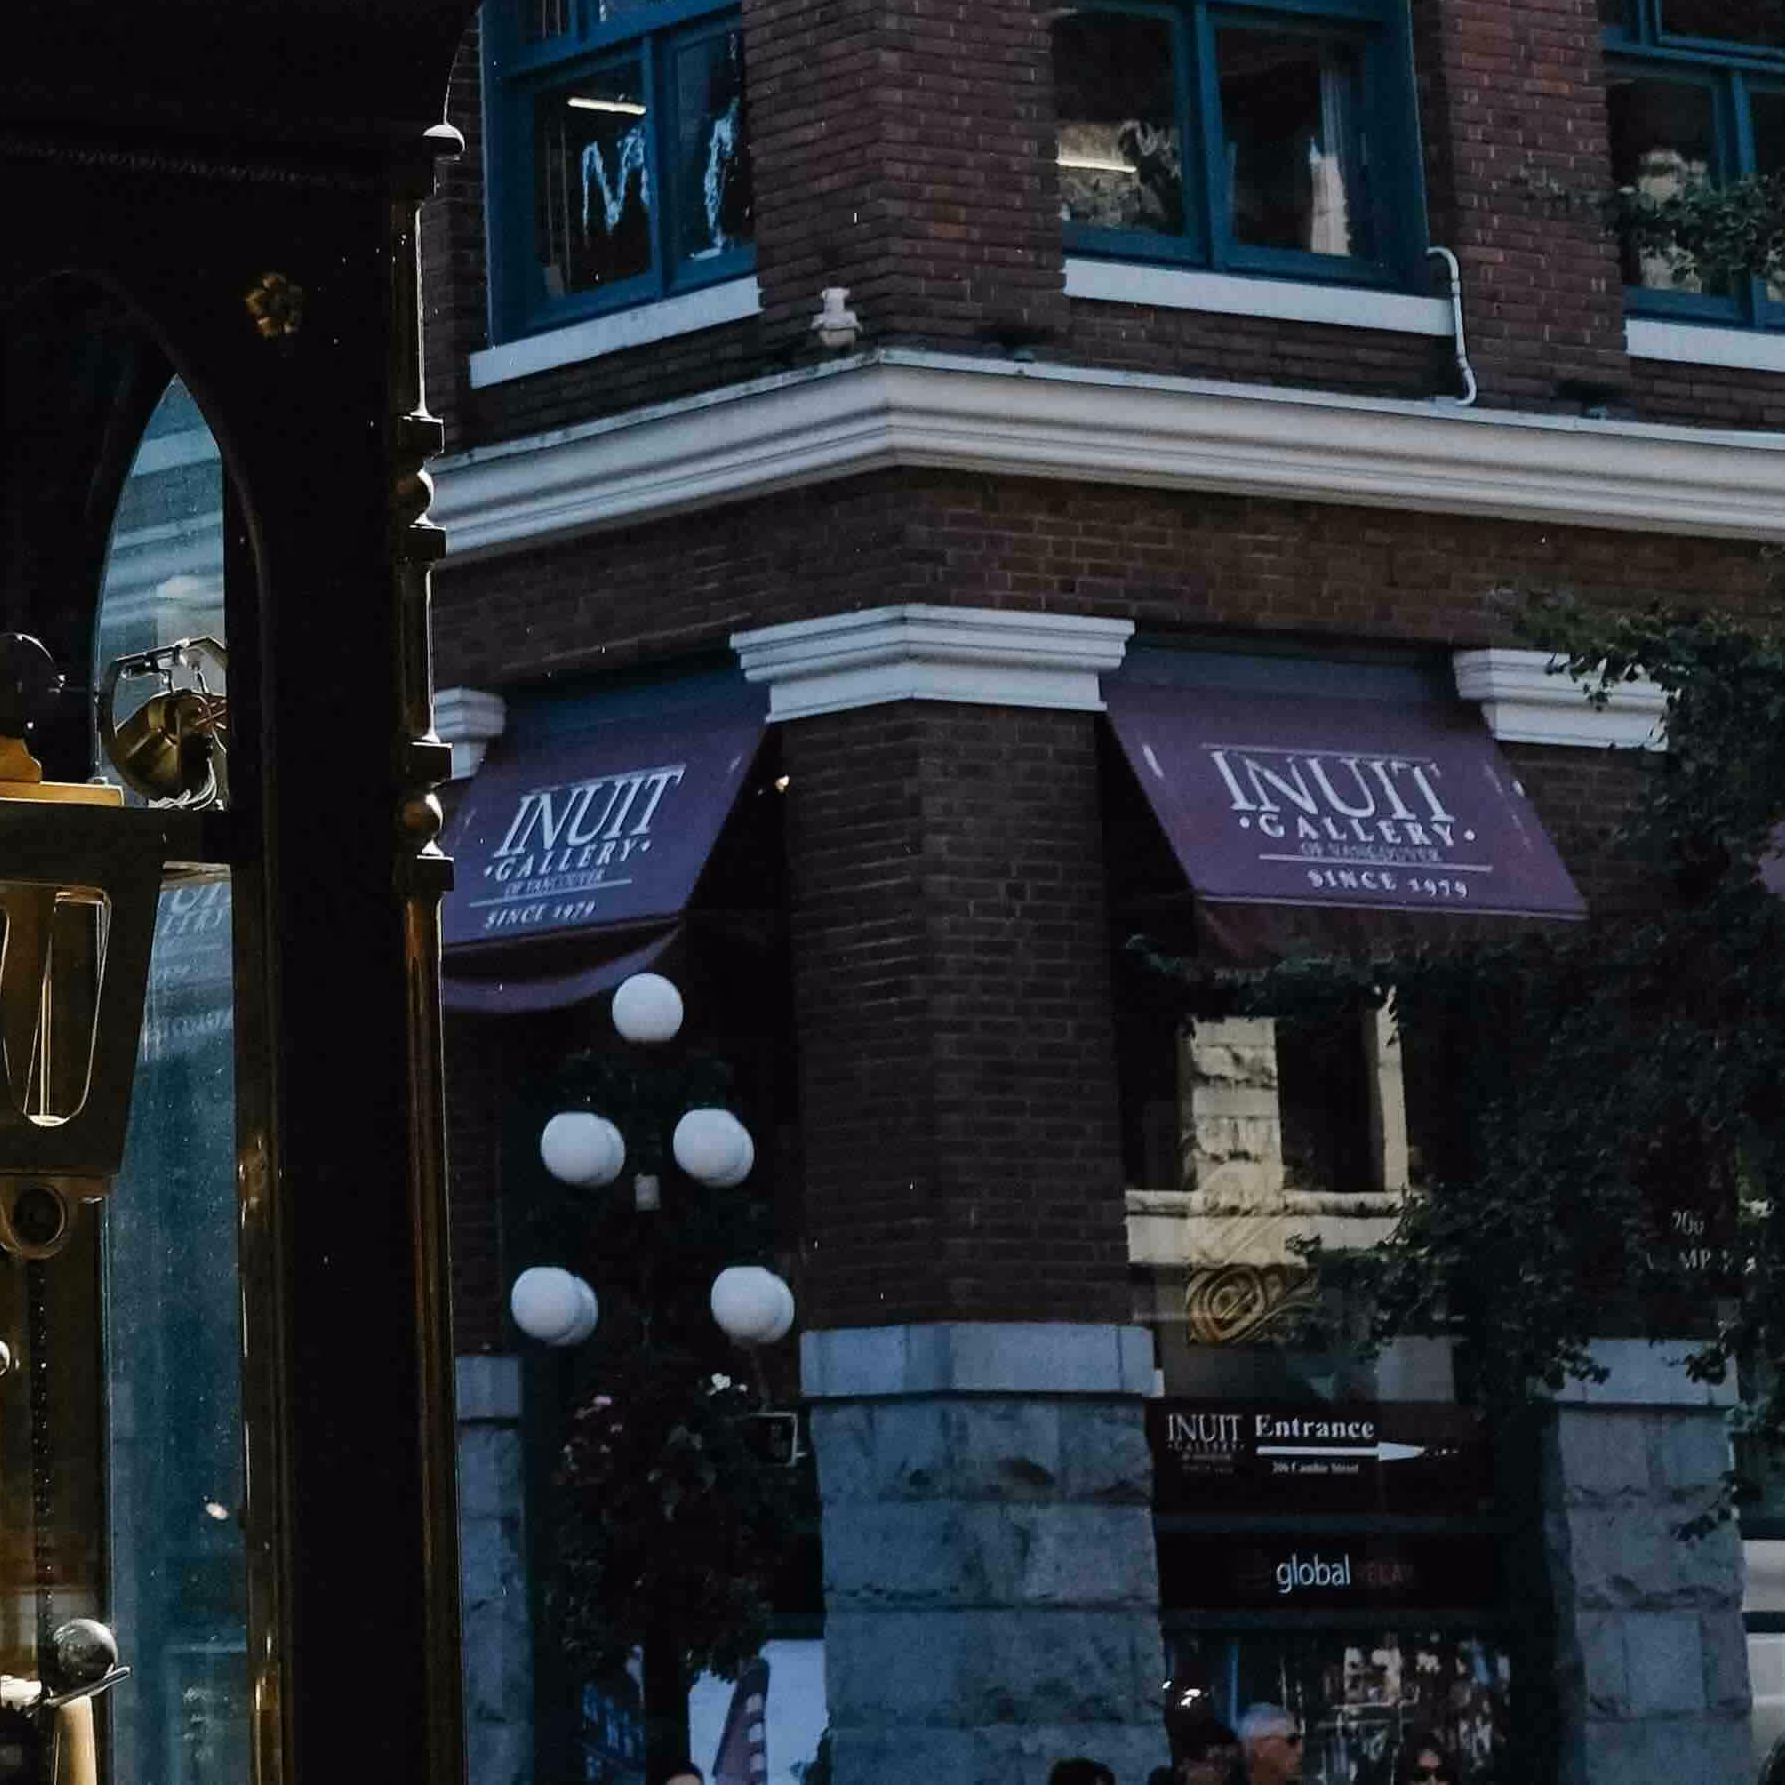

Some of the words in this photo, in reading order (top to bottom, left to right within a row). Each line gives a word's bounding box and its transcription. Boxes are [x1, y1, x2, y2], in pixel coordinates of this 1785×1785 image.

[1211, 749, 1456, 822] INUIT
[494, 769, 686, 858] INUIT
[1307, 869, 1398, 890] SINCE
[484, 903, 545, 929] SINCE
[1166, 1413, 1245, 1444] INUIT
[1254, 1413, 1375, 1439] Entrance
[1276, 1551, 1351, 1596] global
